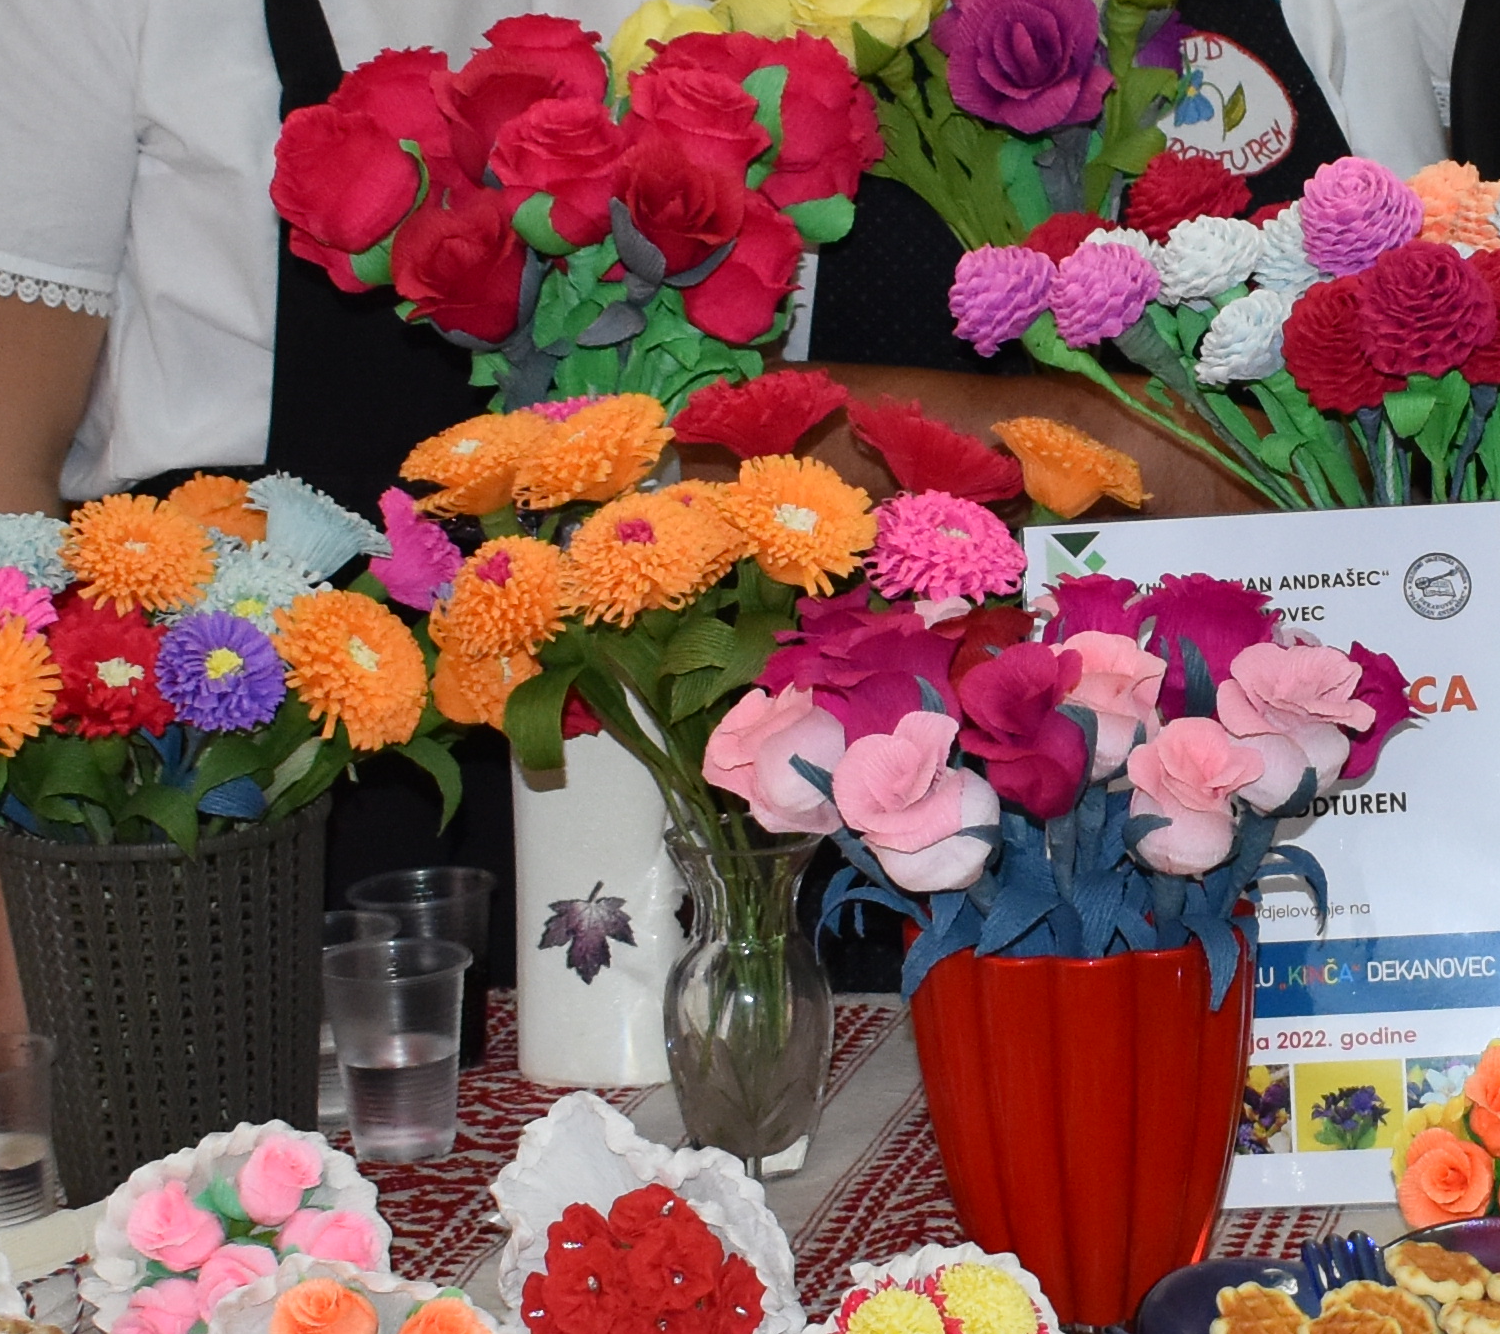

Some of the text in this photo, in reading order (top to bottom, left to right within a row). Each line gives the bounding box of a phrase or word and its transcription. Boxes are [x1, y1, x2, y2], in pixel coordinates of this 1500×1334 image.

[1182, 39, 1223, 63] UD
[1279, 568, 1389, 591] ANDRAŠEC“
[1350, 903, 1370, 915] na
[1367, 956, 1496, 982] DEKANOVEC
[1277, 1030, 1332, 1049] 2022.
[1340, 1027, 1417, 1050] godine
